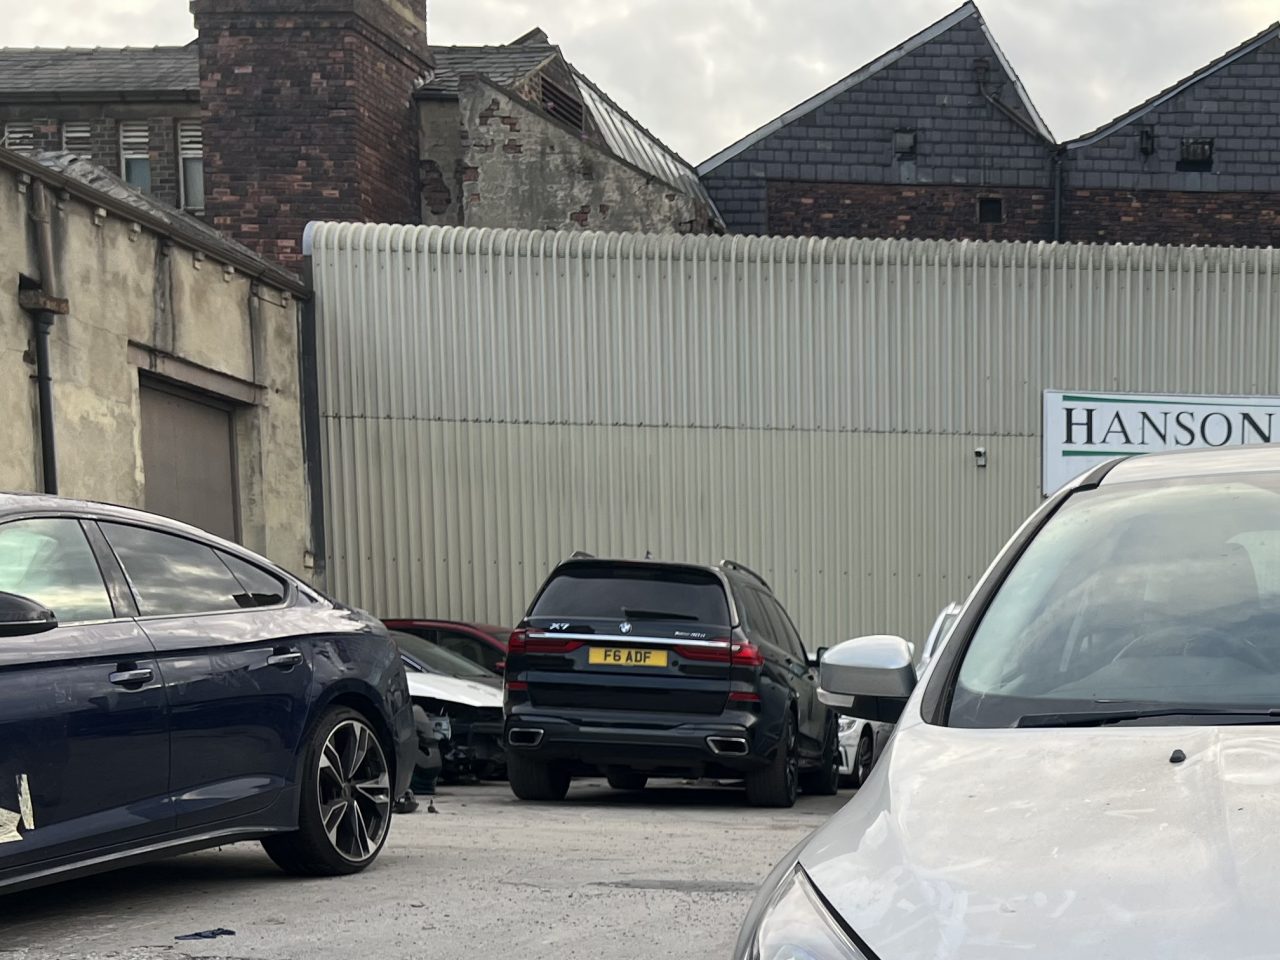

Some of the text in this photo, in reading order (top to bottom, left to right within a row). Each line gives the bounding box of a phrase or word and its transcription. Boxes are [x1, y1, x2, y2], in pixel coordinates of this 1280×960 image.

[1062, 407, 1278, 447] HANSON
[549, 622, 571, 631] X7
[603, 648, 652, 664] F6 ADF
